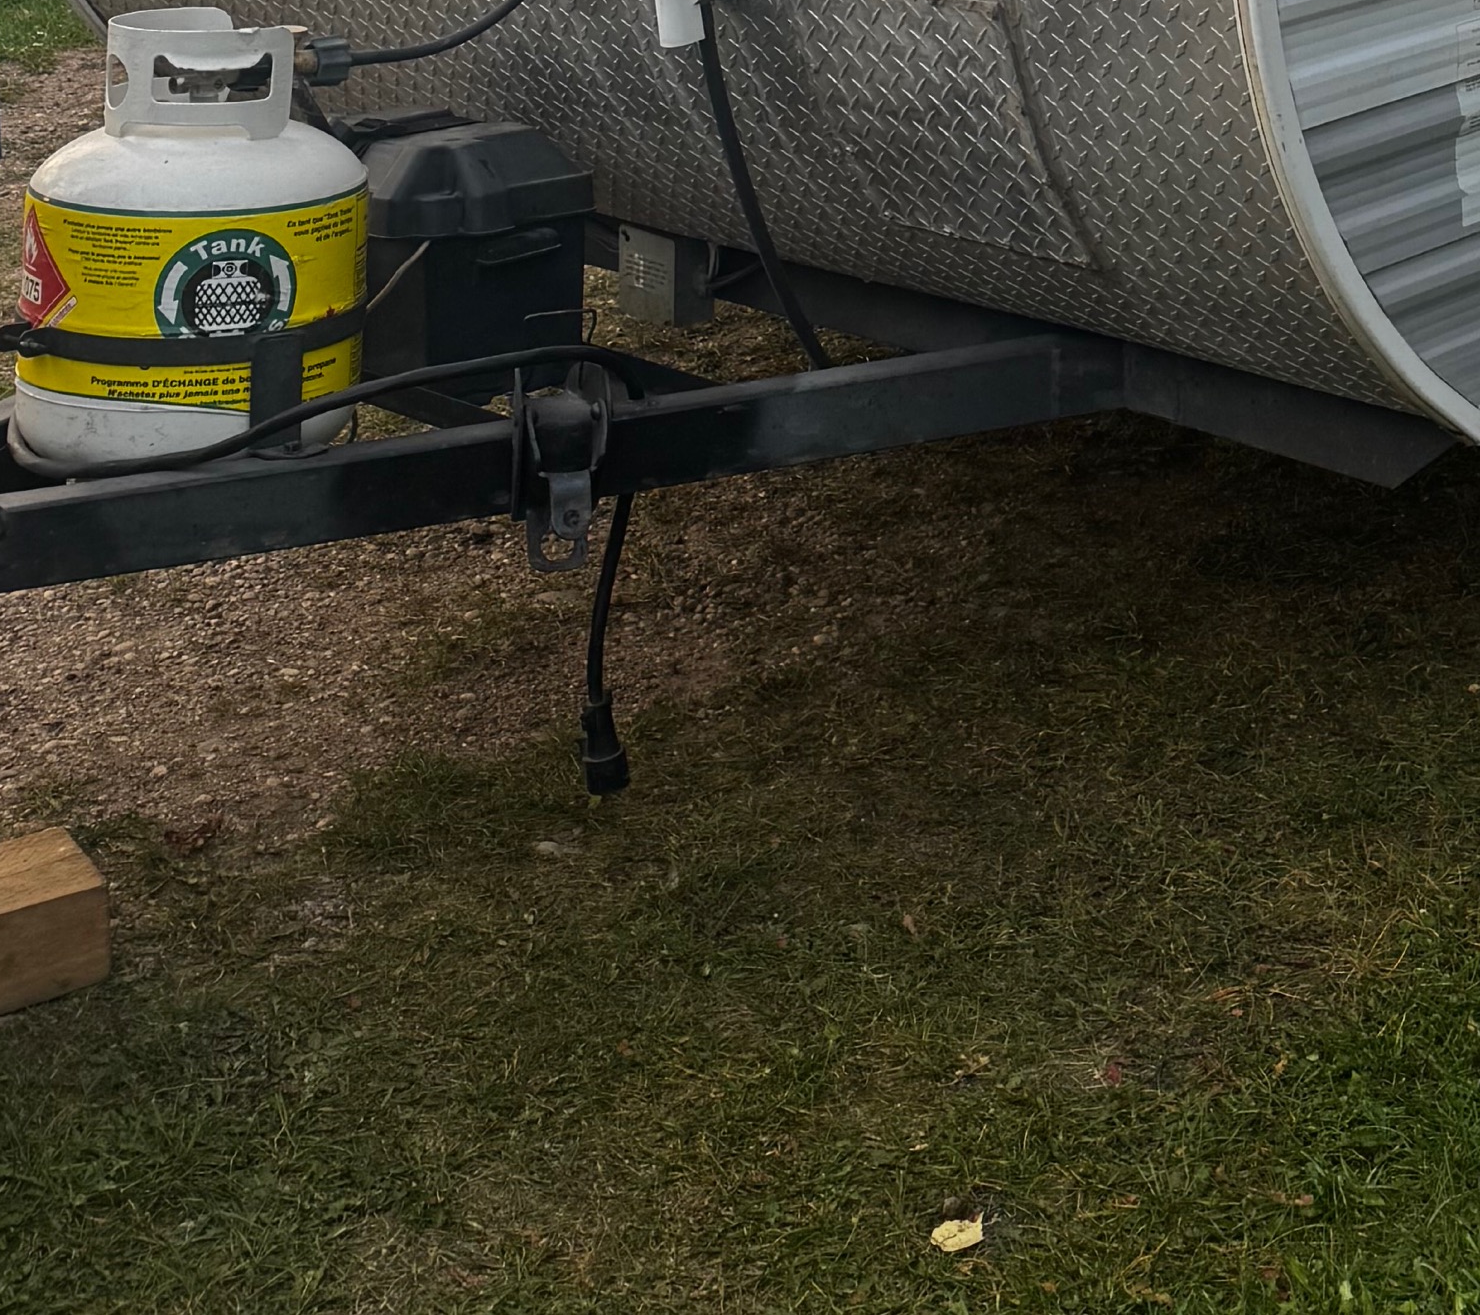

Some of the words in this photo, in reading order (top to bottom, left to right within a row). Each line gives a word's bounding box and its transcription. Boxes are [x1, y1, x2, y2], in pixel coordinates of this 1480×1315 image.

[189, 236, 266, 261] Tank
[90, 375, 149, 388] Programme
[152, 377, 219, 388] D'ÉCHANGE
[222, 376, 236, 385] de
[158, 390, 181, 399] plus
[183, 389, 219, 399] jamais
[221, 388, 241, 396] une
